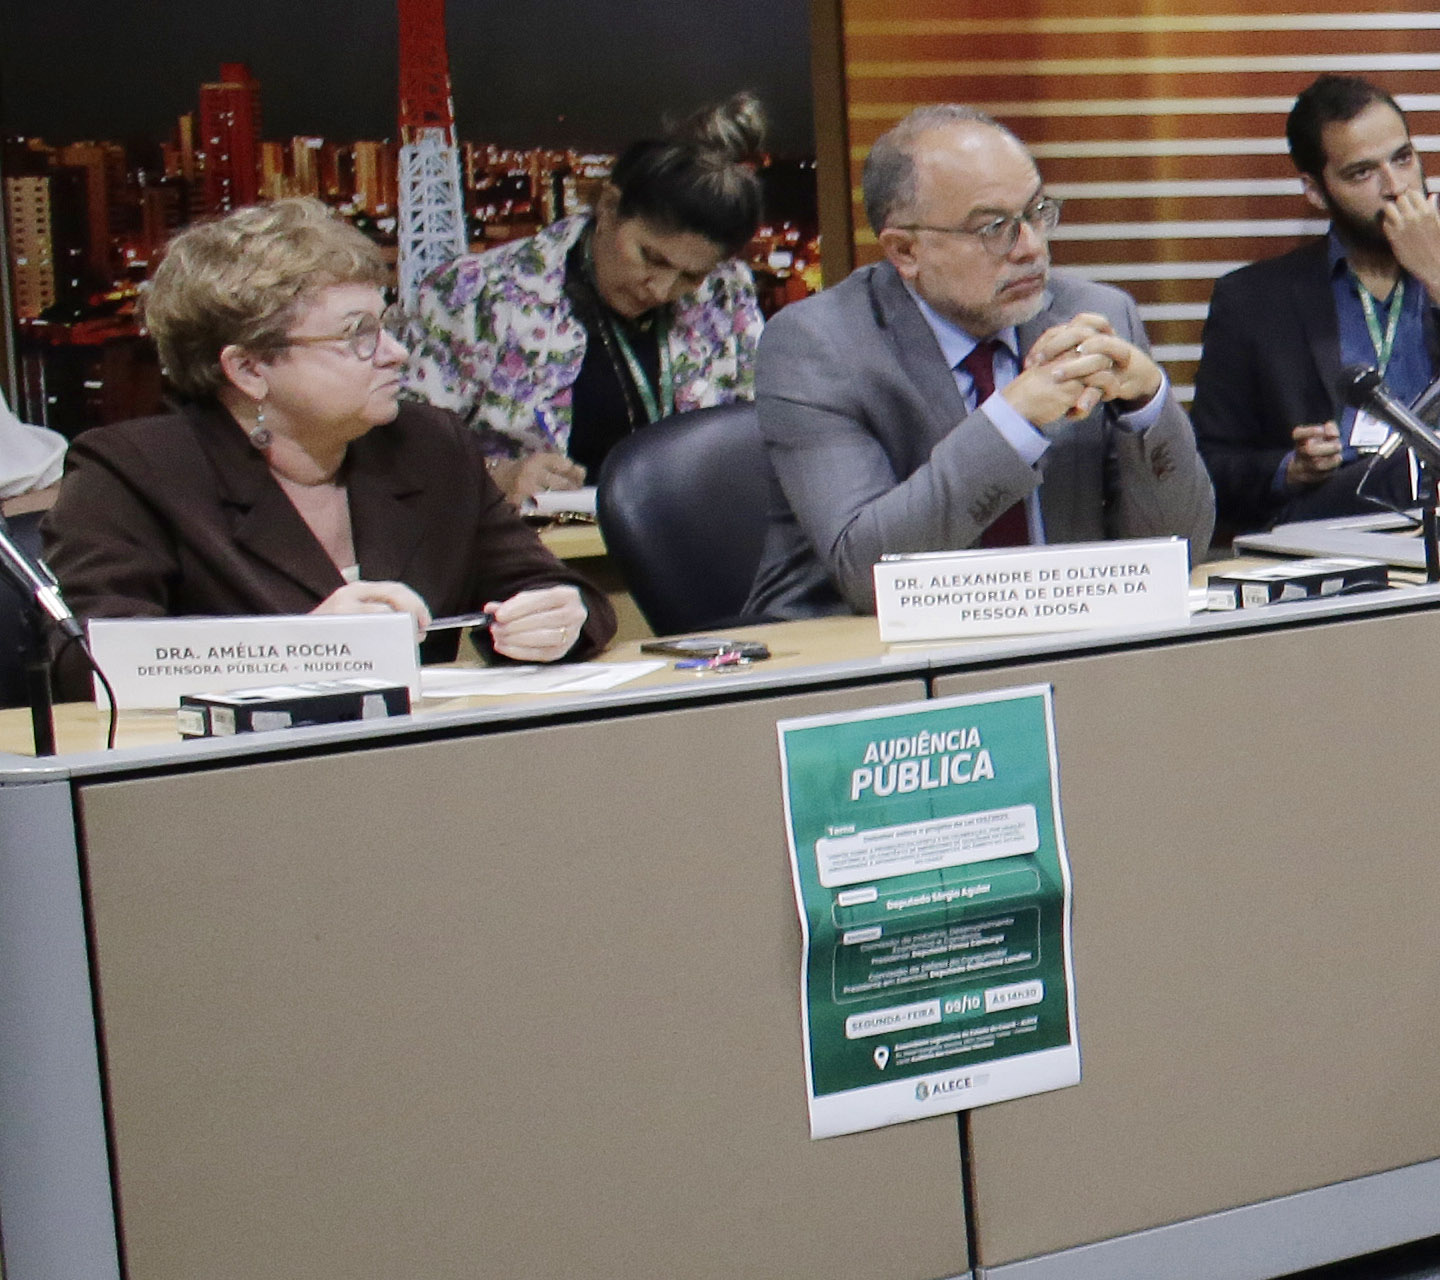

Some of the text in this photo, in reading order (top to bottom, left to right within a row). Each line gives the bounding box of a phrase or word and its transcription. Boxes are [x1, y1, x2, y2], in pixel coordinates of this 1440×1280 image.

[895, 564, 1150, 590] DR. ALEXANDRE DE OLIVEIRA
[901, 582, 1147, 607] PROMOTORIA DE DEFESA DA
[962, 603, 1089, 621] PESSOA IDOSA
[156, 642, 351, 660] DRA. AMÉLIA ROCHA
[138, 665, 219, 676] DEFENSORA
[227, 661, 288, 674] PÚBLICA
[304, 661, 373, 672] NUDECON
[863, 726, 980, 764] AUDIÊNCIA
[851, 749, 994, 800] PÚBLICA
